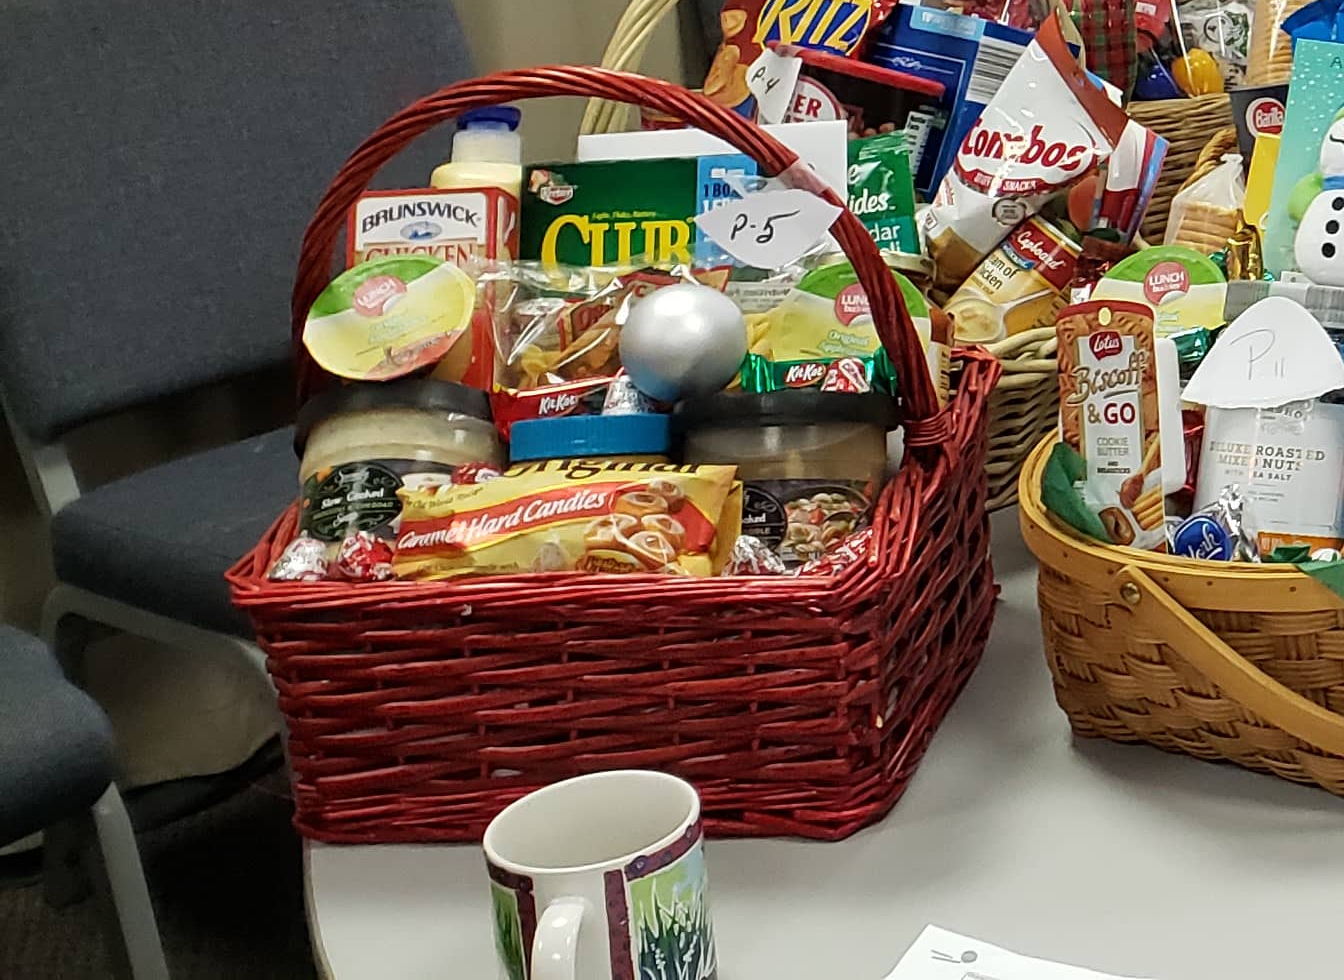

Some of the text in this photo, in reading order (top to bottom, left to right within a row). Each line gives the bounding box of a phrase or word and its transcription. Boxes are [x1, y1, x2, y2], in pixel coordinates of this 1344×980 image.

[361, 201, 478, 233] BRUNSWICK
[730, 210, 800, 243] P-5
[1149, 273, 1185, 285] LUNCH
[1092, 335, 1120, 354] Lotus
[1067, 351, 1148, 406] Biscoff
[1087, 402, 1136, 424] & GO
[1097, 437, 1129, 447] COOKIE
[1097, 447, 1129, 457] BUTTER
[1255, 445, 1326, 461] ROASTED
[1267, 472, 1293, 481] SALT
[399, 489, 608, 550] Caramel Hard Candies
